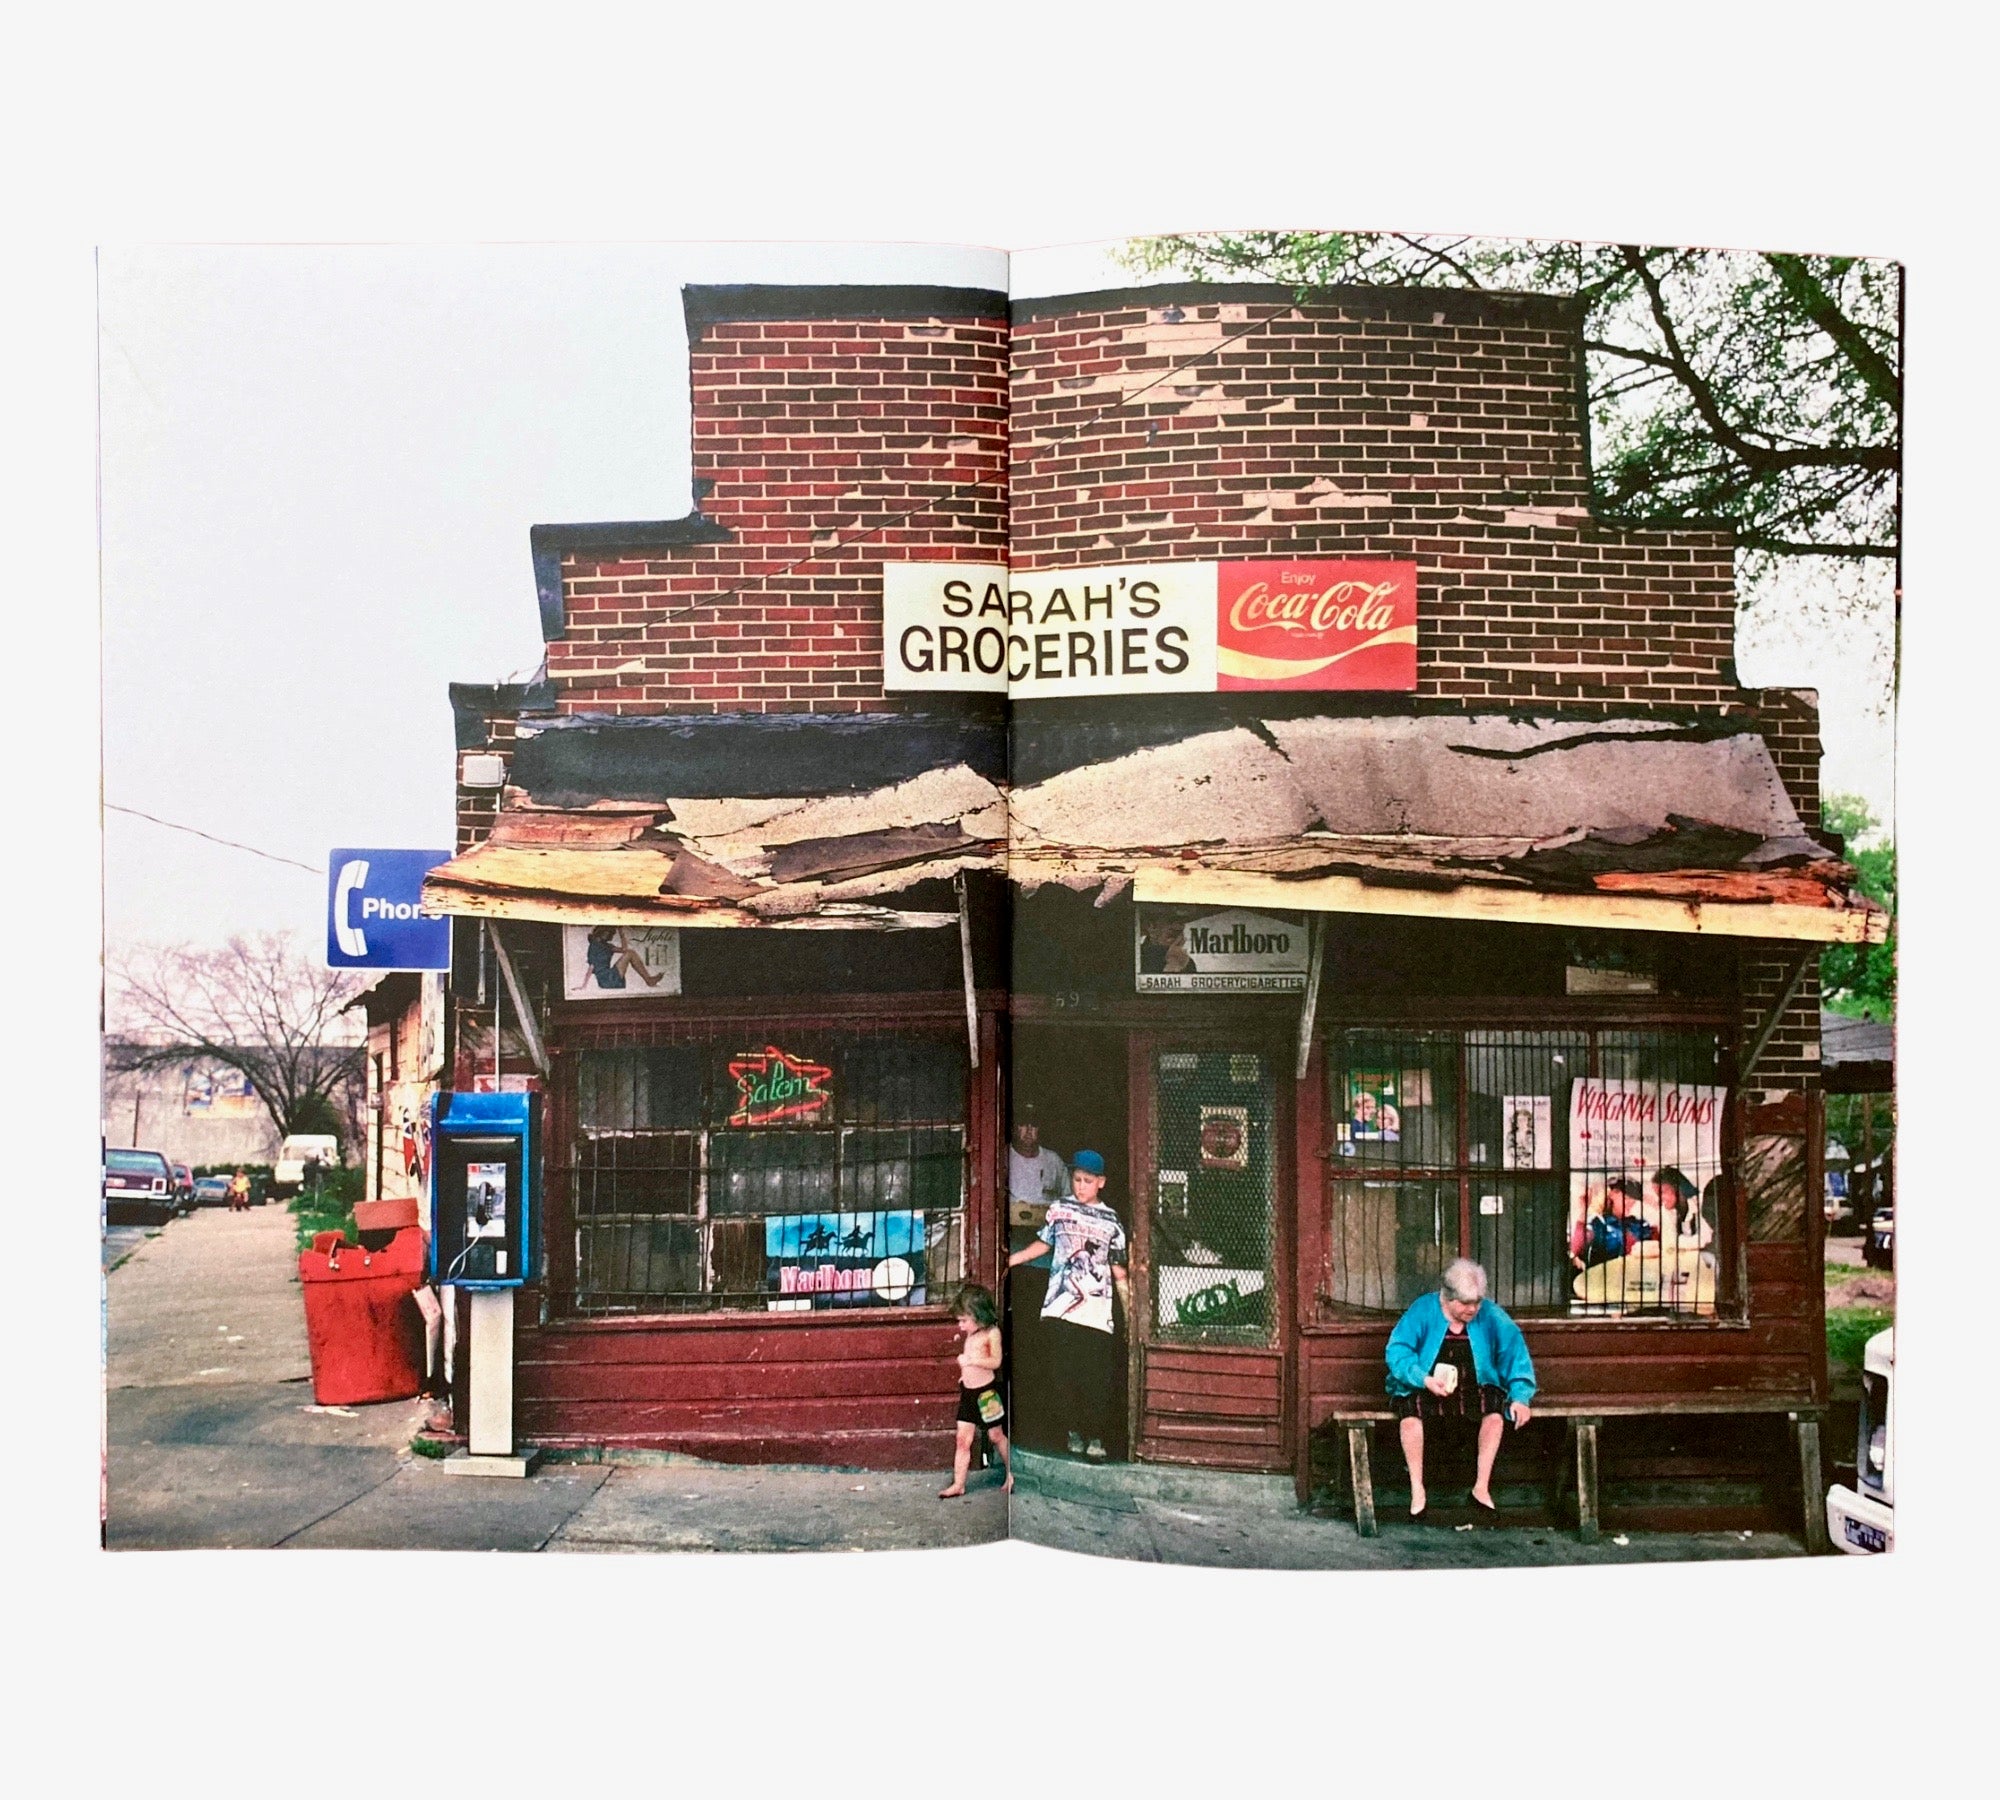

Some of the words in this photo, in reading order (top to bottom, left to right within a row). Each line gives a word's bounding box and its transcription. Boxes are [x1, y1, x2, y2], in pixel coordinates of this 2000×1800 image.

[1281, 571, 1316, 586] Enjoy
[942, 577, 1161, 626] SARAH'S
[1229, 581, 1401, 632] Coca-Cola
[899, 625, 1190, 682] GROCERIES
[362, 897, 444, 920] Phon
[1189, 924, 1290, 954] Marlboro
[1146, 977, 1181, 988] SARAH
[1577, 1085, 1657, 1122] VIRGINIA
[1660, 1089, 1718, 1126] SLIMS
